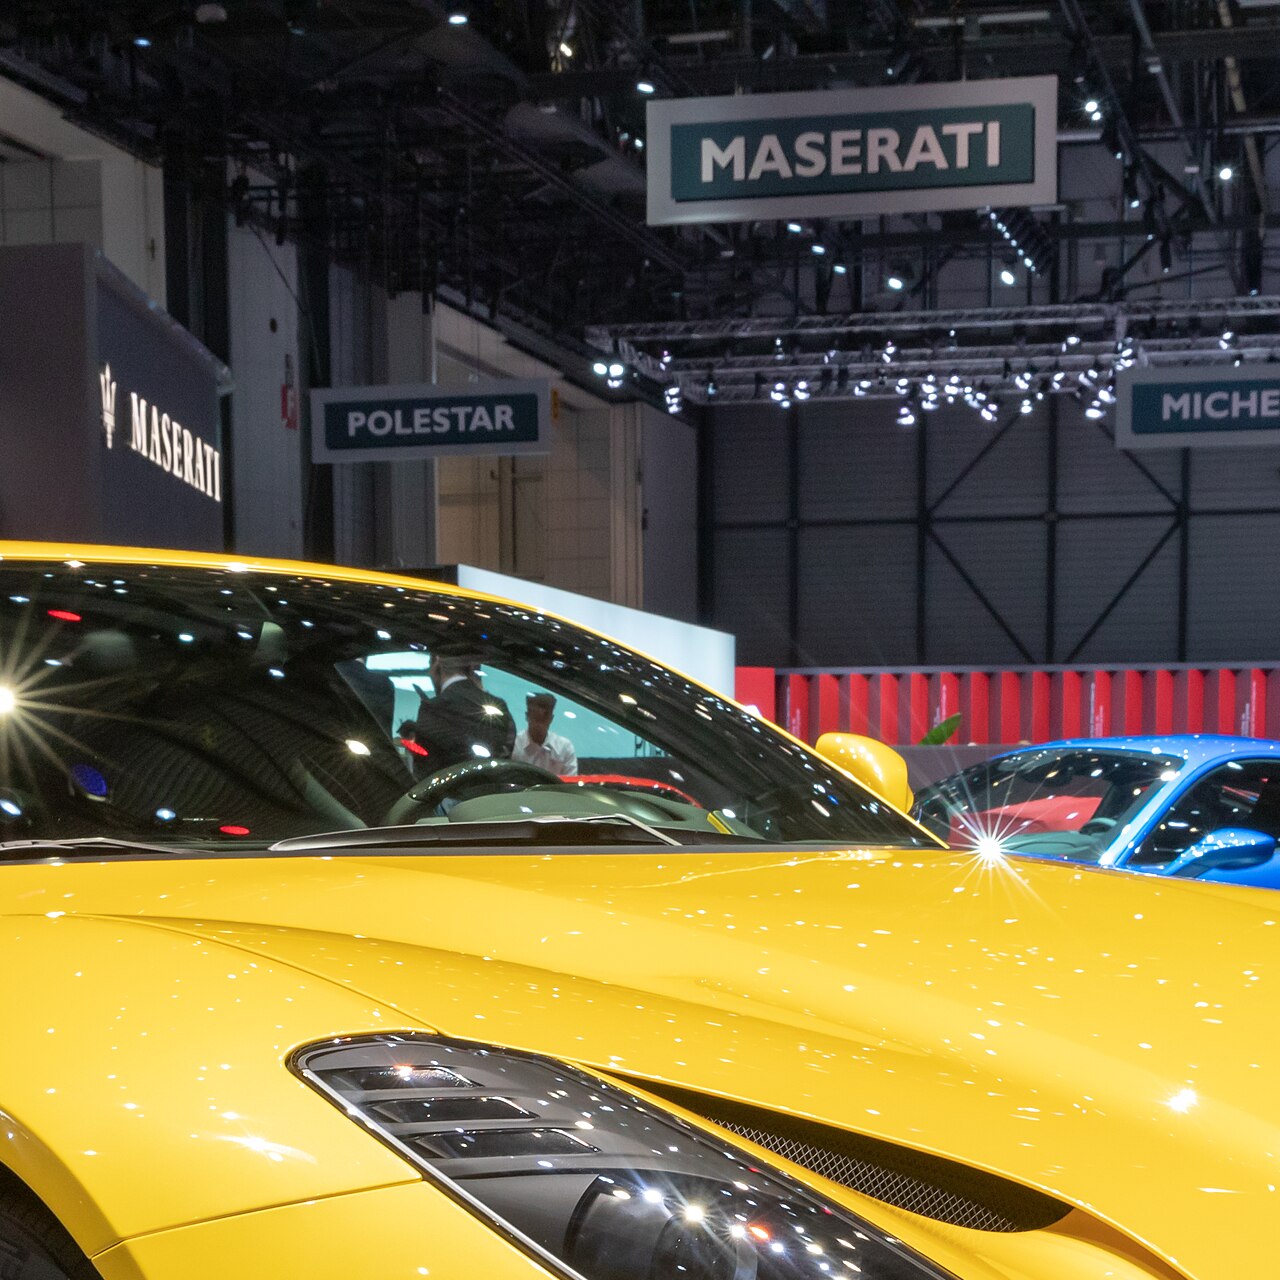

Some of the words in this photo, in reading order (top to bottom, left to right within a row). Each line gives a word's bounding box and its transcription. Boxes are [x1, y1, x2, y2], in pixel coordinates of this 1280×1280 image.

[701, 121, 1000, 183] MASERATI
[130, 391, 221, 502] MASERATI
[347, 404, 515, 437] POLESTAR
